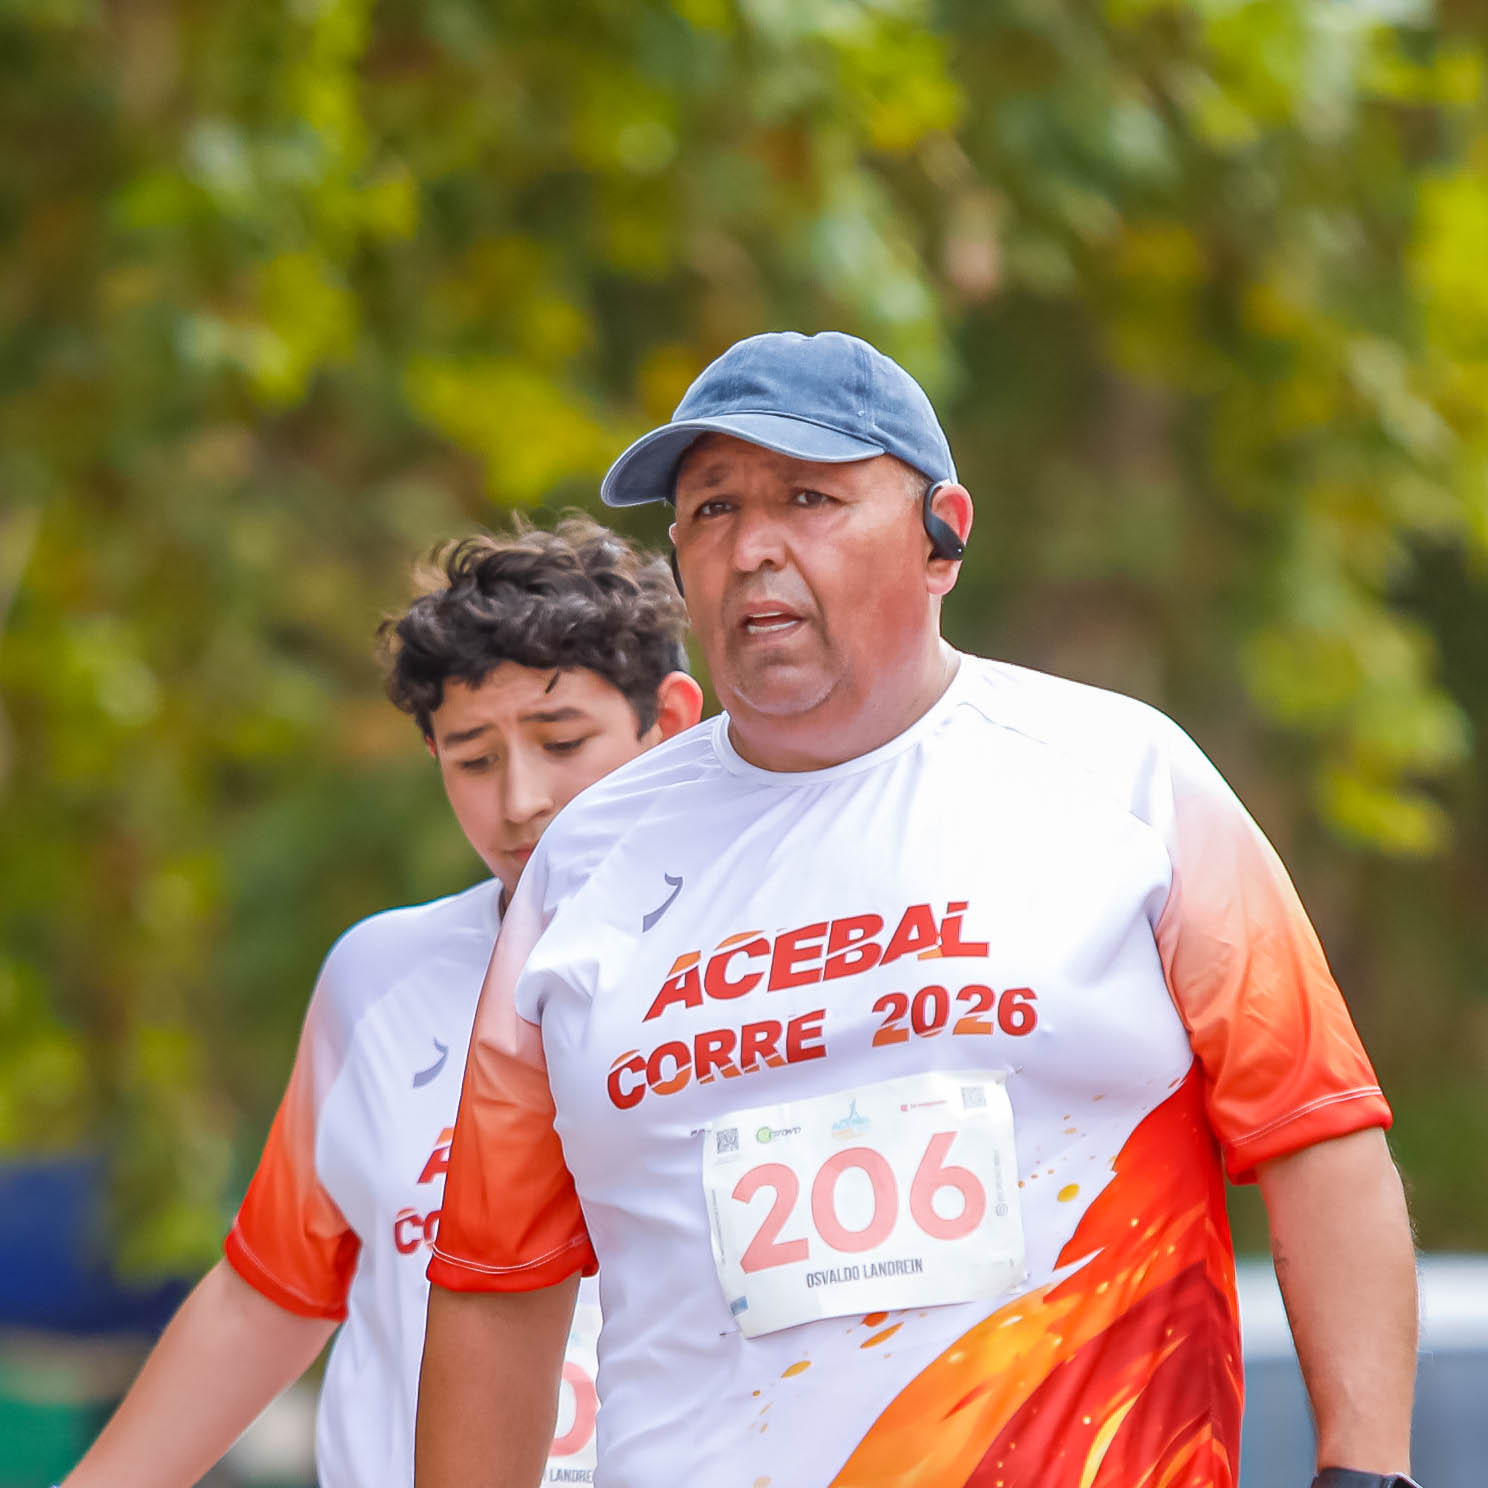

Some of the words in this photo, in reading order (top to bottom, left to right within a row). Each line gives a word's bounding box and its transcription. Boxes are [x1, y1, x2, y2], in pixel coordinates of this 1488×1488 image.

[641, 900, 990, 1023] ACEBAL
[607, 1008, 828, 1110] CORRE
[871, 984, 1039, 1049] 2026
[731, 1130, 987, 1275] 206
[806, 1265, 861, 1288] OSVALDO
[863, 1257, 924, 1280] LANDREIN
